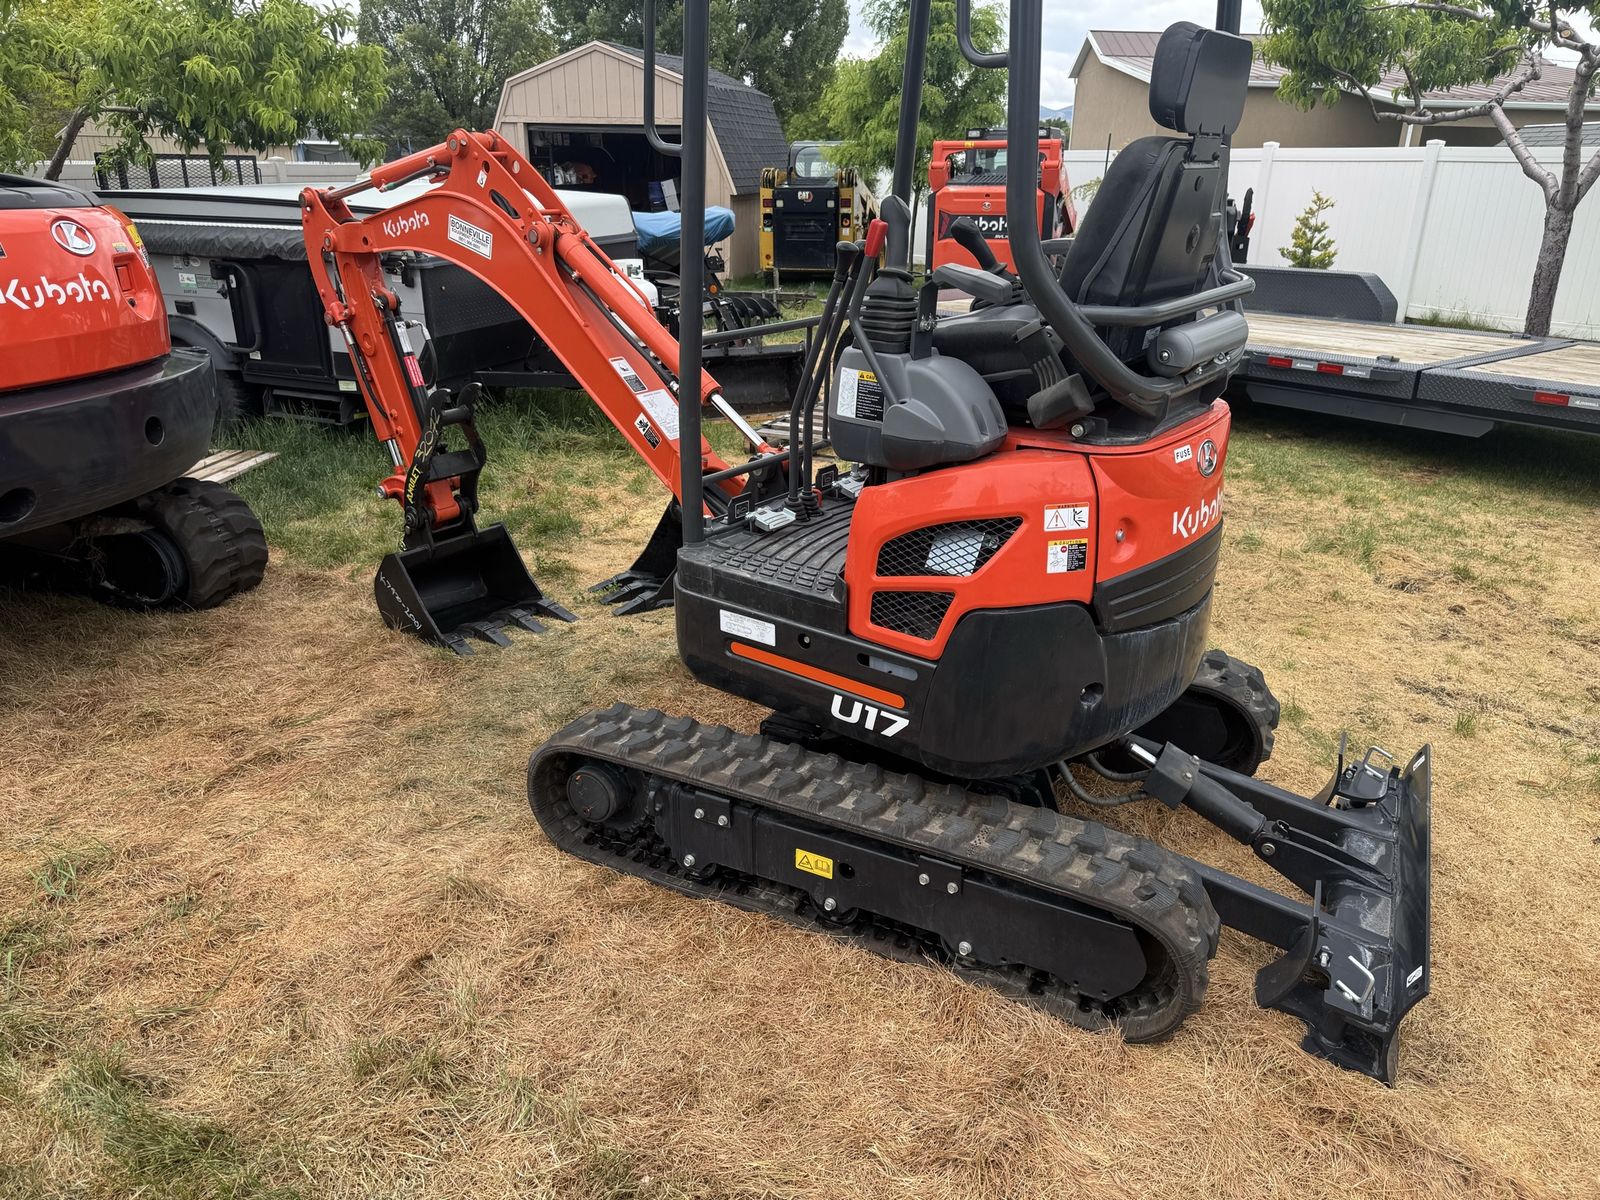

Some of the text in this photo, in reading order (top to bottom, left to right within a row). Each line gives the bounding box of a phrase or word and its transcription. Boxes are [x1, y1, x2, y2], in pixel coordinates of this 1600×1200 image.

[798, 191, 809, 200] CAT
[382, 210, 430, 238] Kubota
[450, 219, 490, 245] BONNEVILLE
[974, 216, 1007, 232] bot
[0, 273, 111, 309] Kubota
[1176, 448, 1191, 460] FUSE
[406, 464, 423, 504] AMULET
[830, 694, 910, 738] U17
